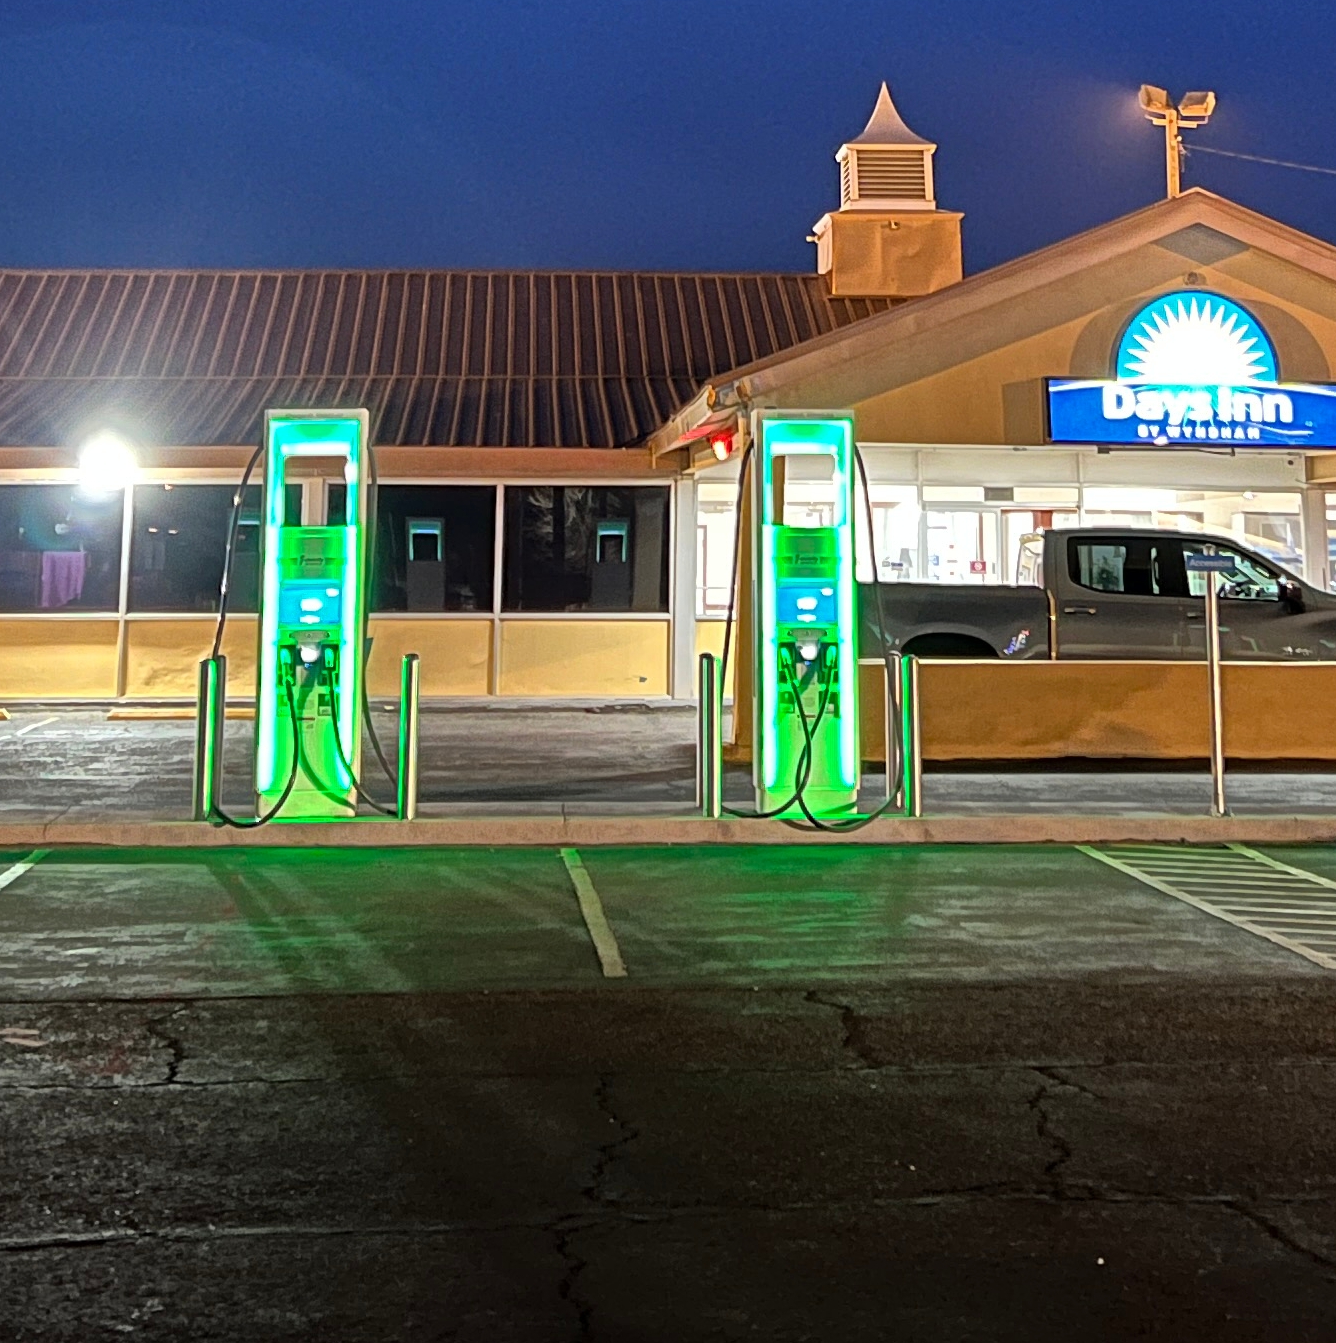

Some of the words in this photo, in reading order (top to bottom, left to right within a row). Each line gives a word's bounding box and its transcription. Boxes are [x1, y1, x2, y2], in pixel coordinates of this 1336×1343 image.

[1102, 385, 1214, 425] Days
[1217, 386, 1294, 423] Inn
[1137, 425, 1159, 438] BY
[1166, 425, 1261, 440] WYNDHAM
